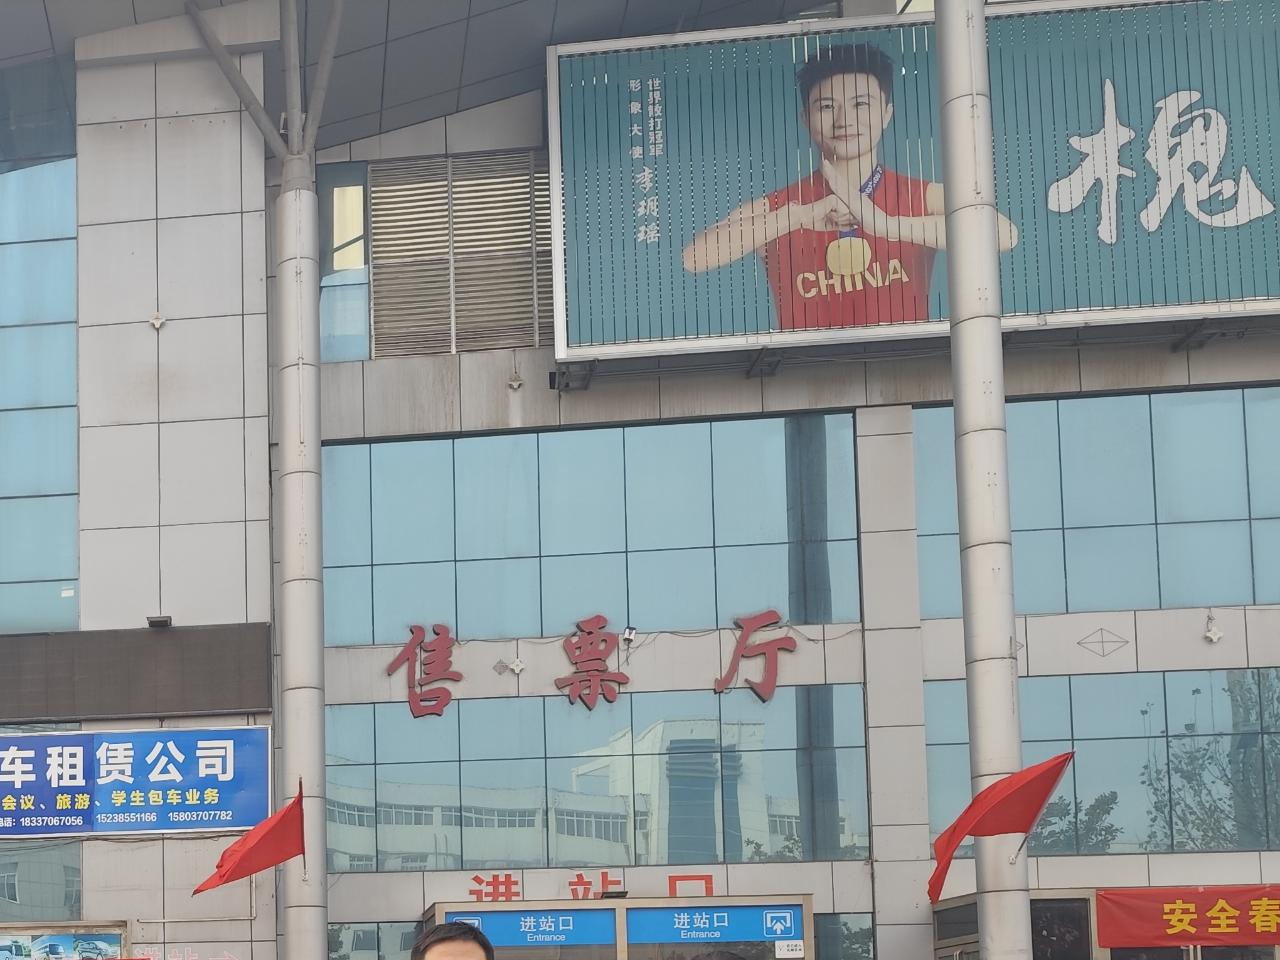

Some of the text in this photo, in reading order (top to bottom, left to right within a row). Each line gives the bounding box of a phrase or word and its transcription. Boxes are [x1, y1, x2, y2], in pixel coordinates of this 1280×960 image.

[387, 608, 797, 719] 售票厅
[96, 813, 158, 825] 15238551166
[168, 811, 233, 822] 15803707782
[519, 916, 575, 932] 进站口
[673, 912, 729, 929] 进站口
[1162, 898, 1280, 935] 安全春
[527, 933, 567, 942] Entrance
[681, 930, 721, 939] Entrance
